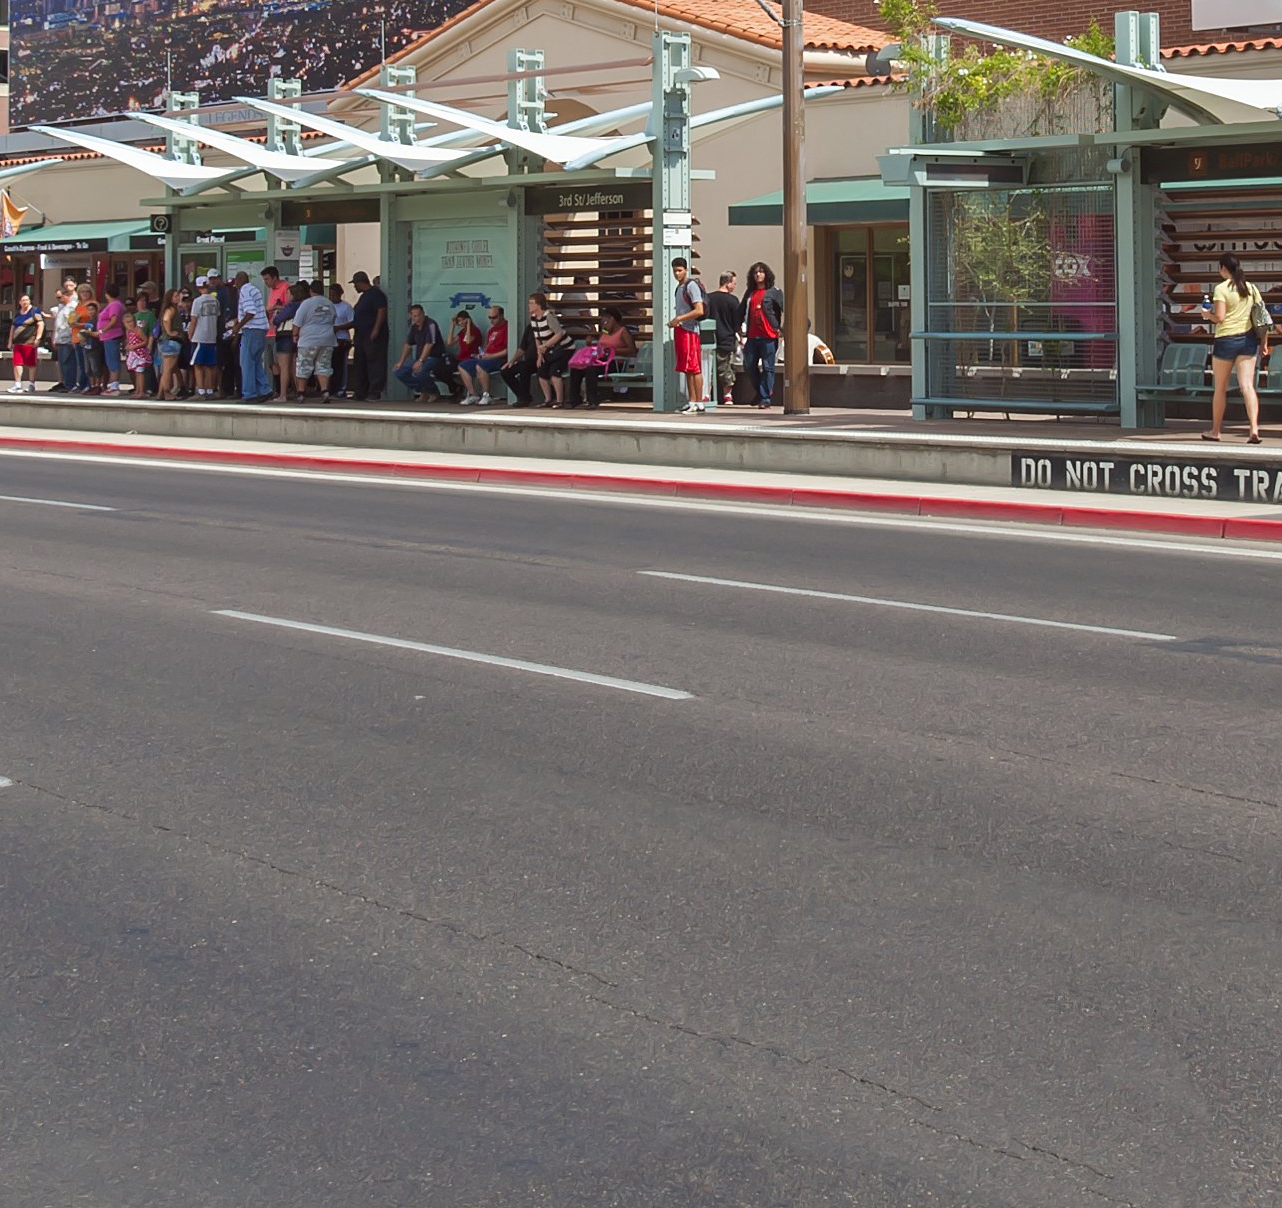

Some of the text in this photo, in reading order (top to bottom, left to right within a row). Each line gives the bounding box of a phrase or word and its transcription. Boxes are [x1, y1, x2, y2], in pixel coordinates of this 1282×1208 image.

[558, 194, 572, 208] 3rd
[586, 192, 624, 206] Jefferson
[1020, 457, 1052, 488] DO
[1066, 460, 1115, 491] NOT
[1129, 463, 1218, 497] CROSS
